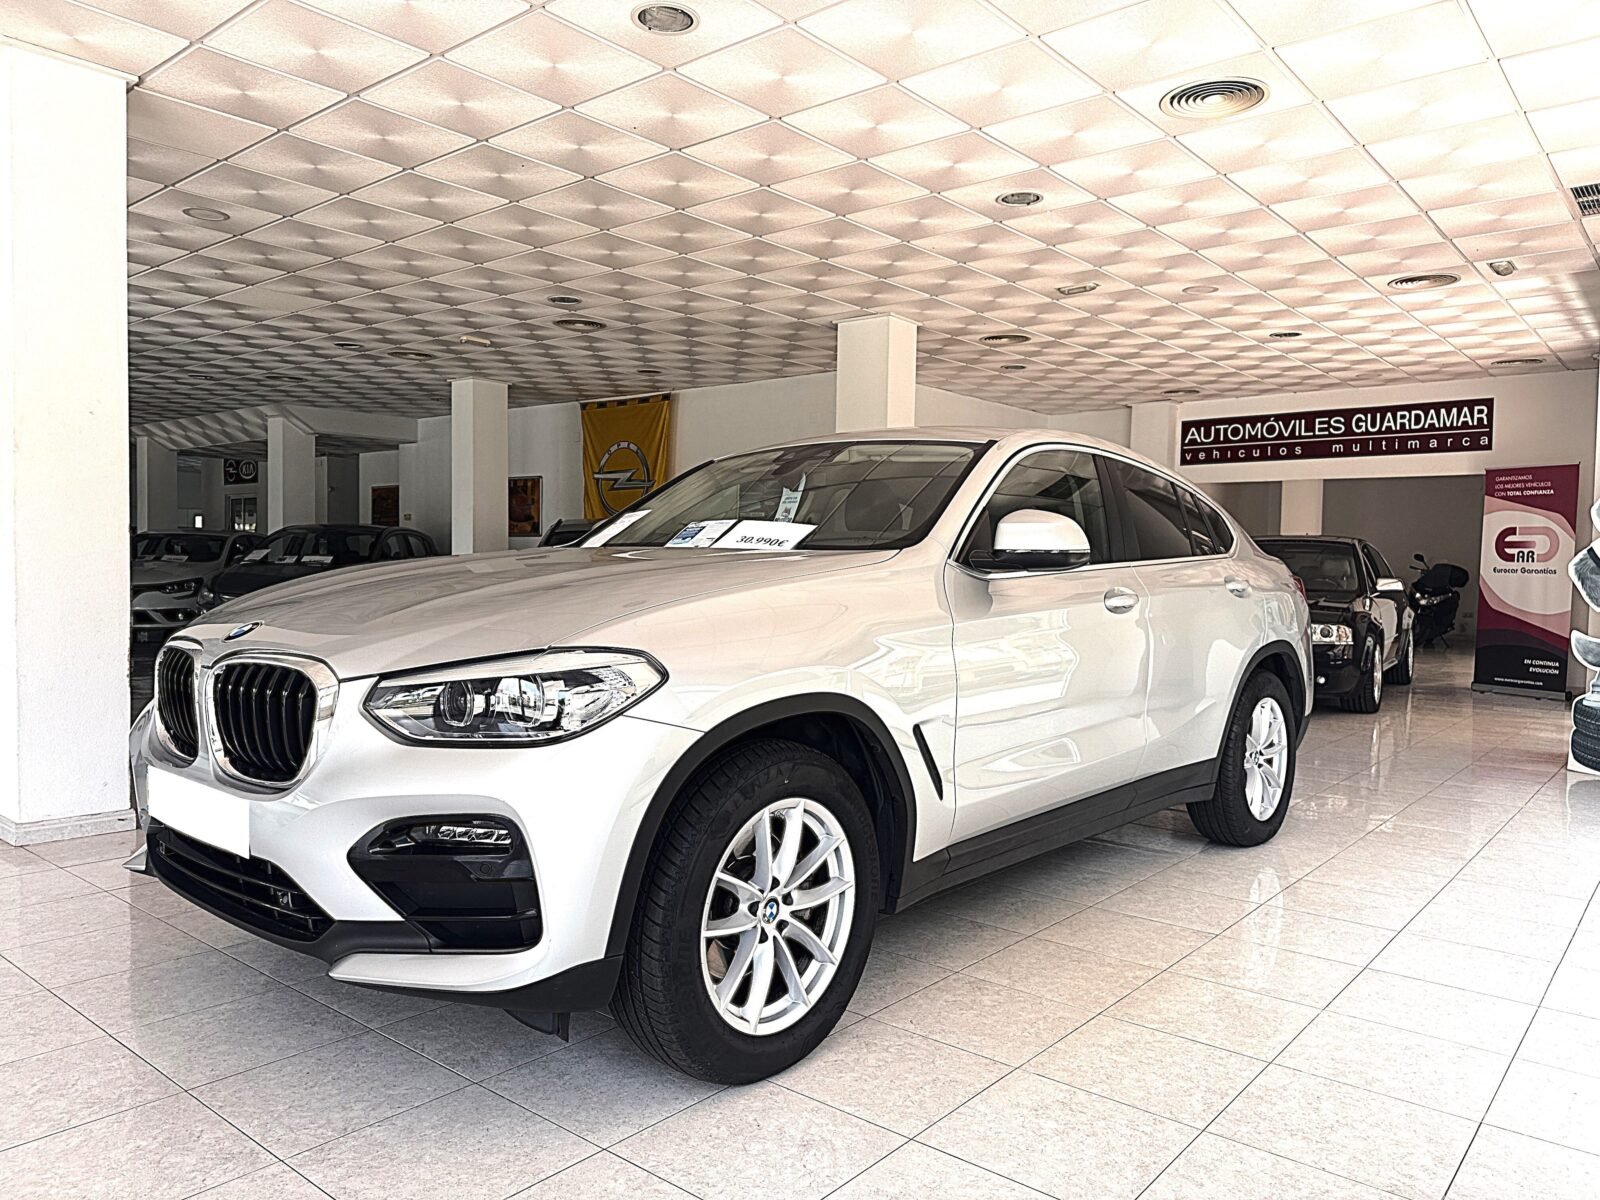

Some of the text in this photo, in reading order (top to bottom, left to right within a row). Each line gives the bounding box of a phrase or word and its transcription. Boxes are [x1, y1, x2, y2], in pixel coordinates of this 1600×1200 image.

[1184, 405, 1488, 444] AUTOMÓVILES GUARDAMAR
[1332, 435, 1489, 453] multimarca
[1495, 474, 1532, 482] GARANTIZAMOS
[735, 535, 790, 547] 30.990€
[1493, 566, 1518, 574] Eurocar
